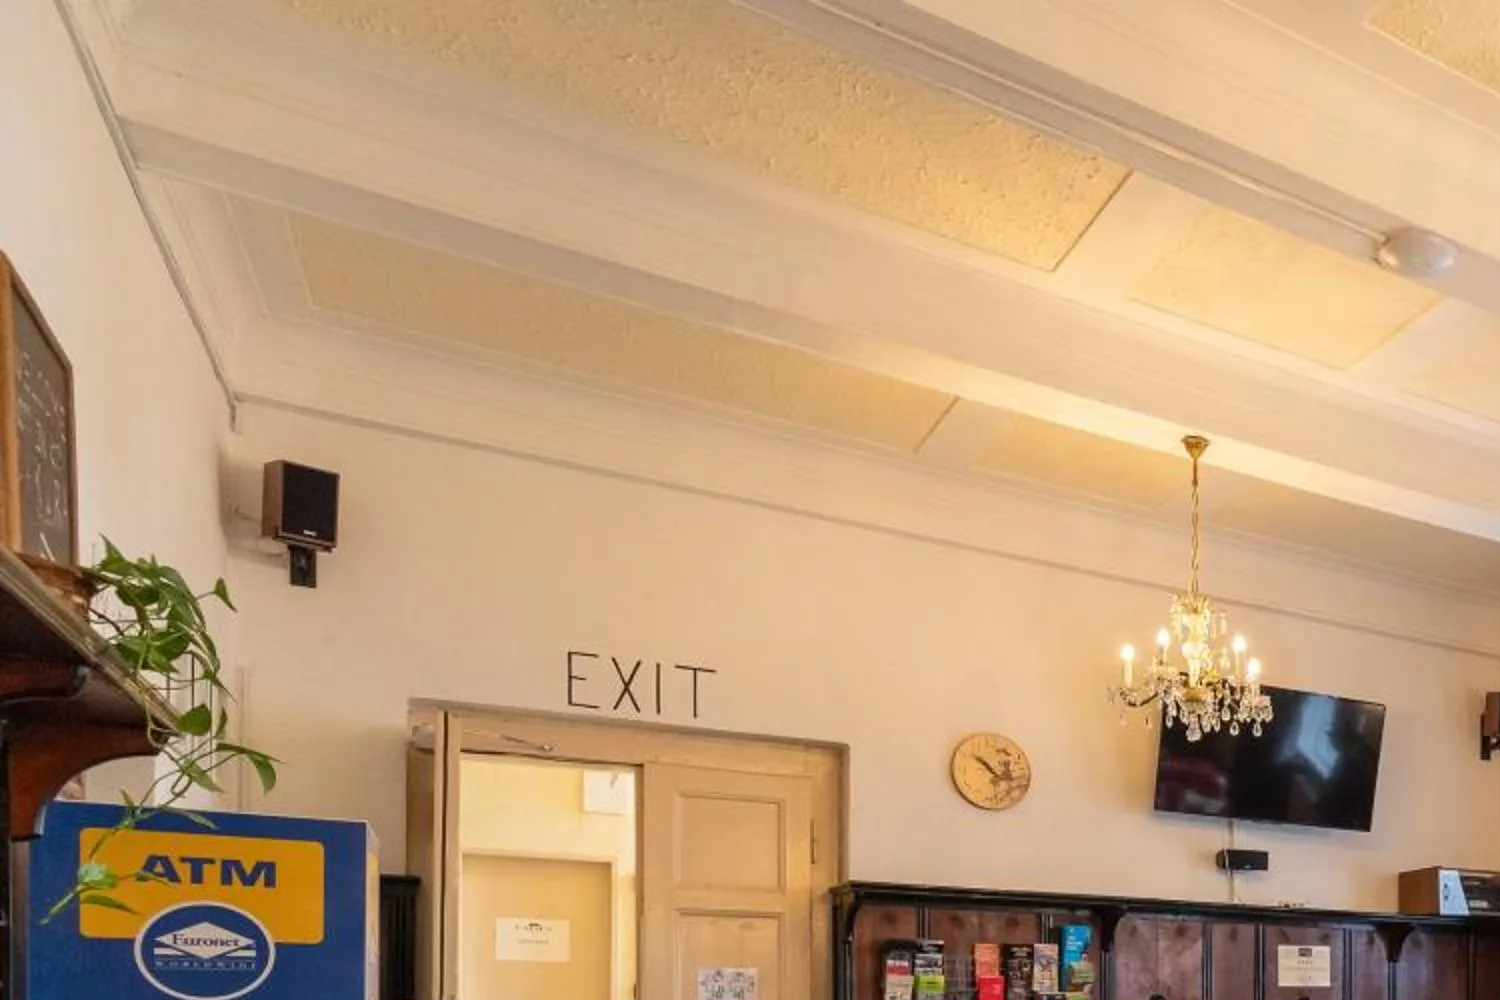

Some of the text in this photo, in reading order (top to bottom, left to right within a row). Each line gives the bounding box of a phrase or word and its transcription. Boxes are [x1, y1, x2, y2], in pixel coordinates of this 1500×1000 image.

[567, 651, 717, 718] EXIT
[136, 855, 276, 888] ATM
[172, 933, 241, 948] Euronet
